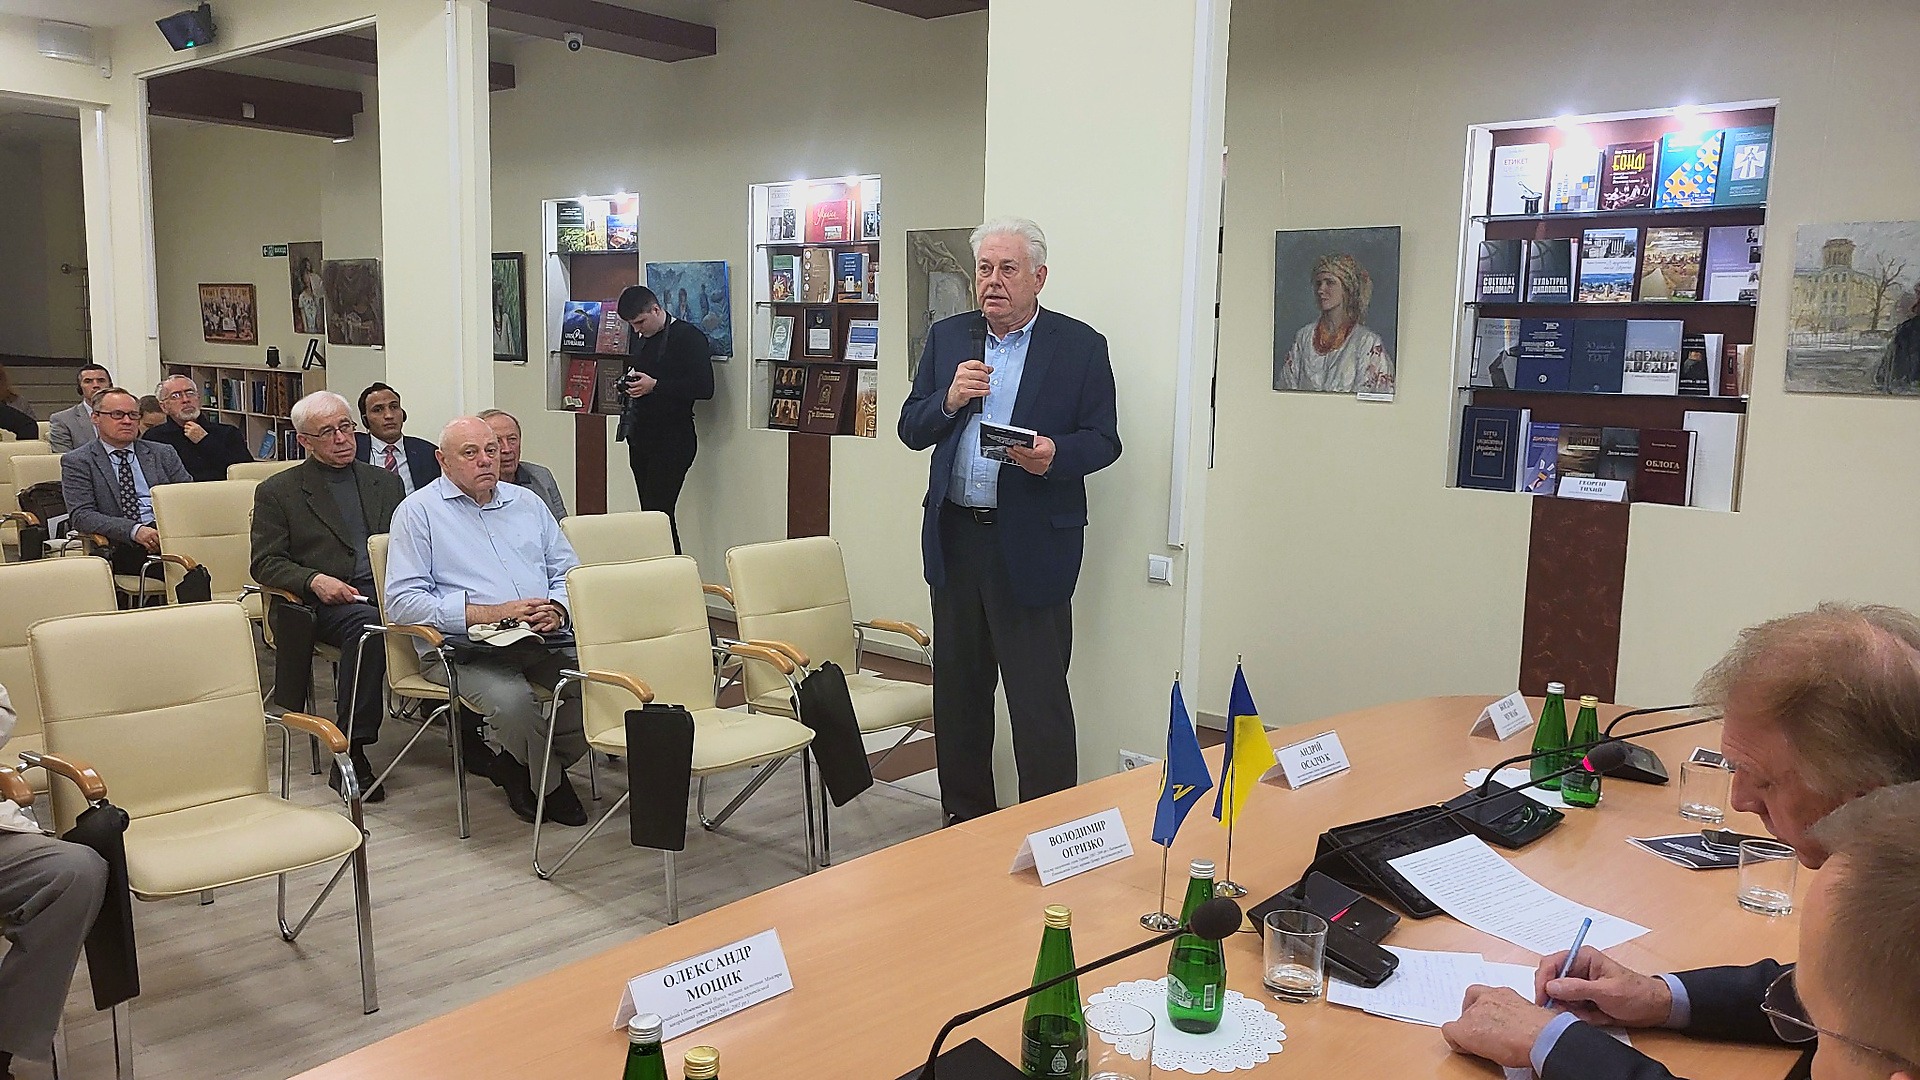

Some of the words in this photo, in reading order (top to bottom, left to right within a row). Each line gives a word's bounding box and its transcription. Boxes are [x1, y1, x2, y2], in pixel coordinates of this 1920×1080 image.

[1645, 459, 1680, 469] ОБЛОГА
[1300, 741, 1323, 757] АНДРІЙ
[1300, 753, 1331, 770] ОСАДЧУК
[1048, 820, 1106, 847] ВОЛОДИМИР
[1062, 837, 1104, 858] ОГРИЗКО
[663, 945, 752, 988] ОЛЕКСАНДР
[686, 969, 743, 1002] МОЦИК
